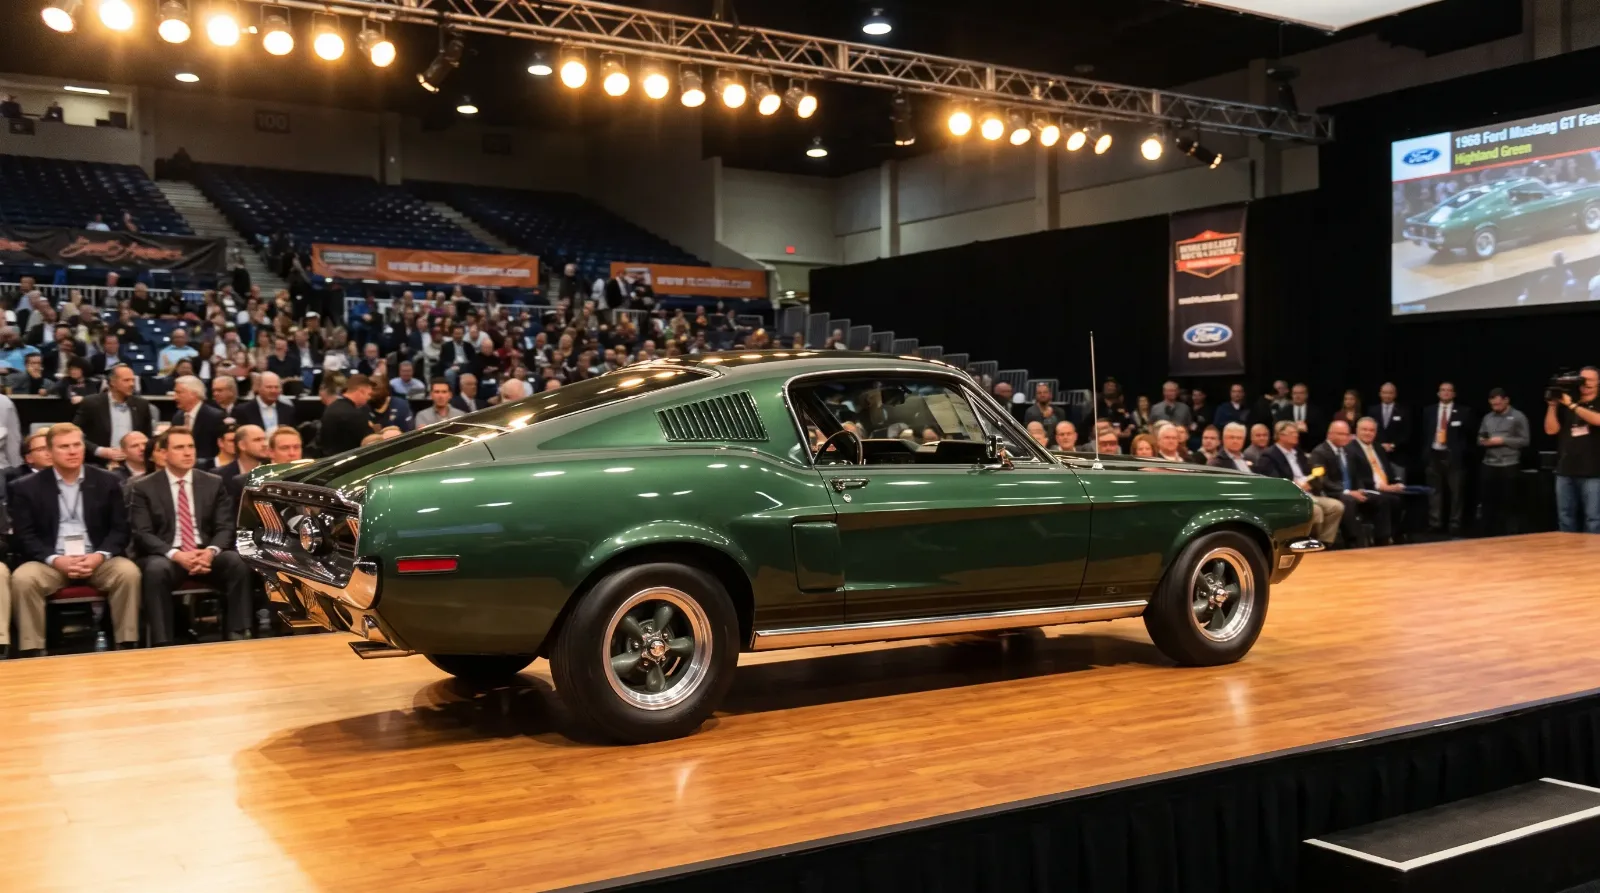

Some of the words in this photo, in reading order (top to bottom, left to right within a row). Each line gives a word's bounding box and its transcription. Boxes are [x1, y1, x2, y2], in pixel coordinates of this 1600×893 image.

[1455, 133, 1481, 149] 1968
[1482, 128, 1507, 144] Ford
[1509, 121, 1558, 139] Mustang
[1560, 115, 1577, 130] GT
[1578, 111, 1600, 127] Fas
[1455, 147, 1499, 166] Highland
[1501, 143, 1532, 157] Green
